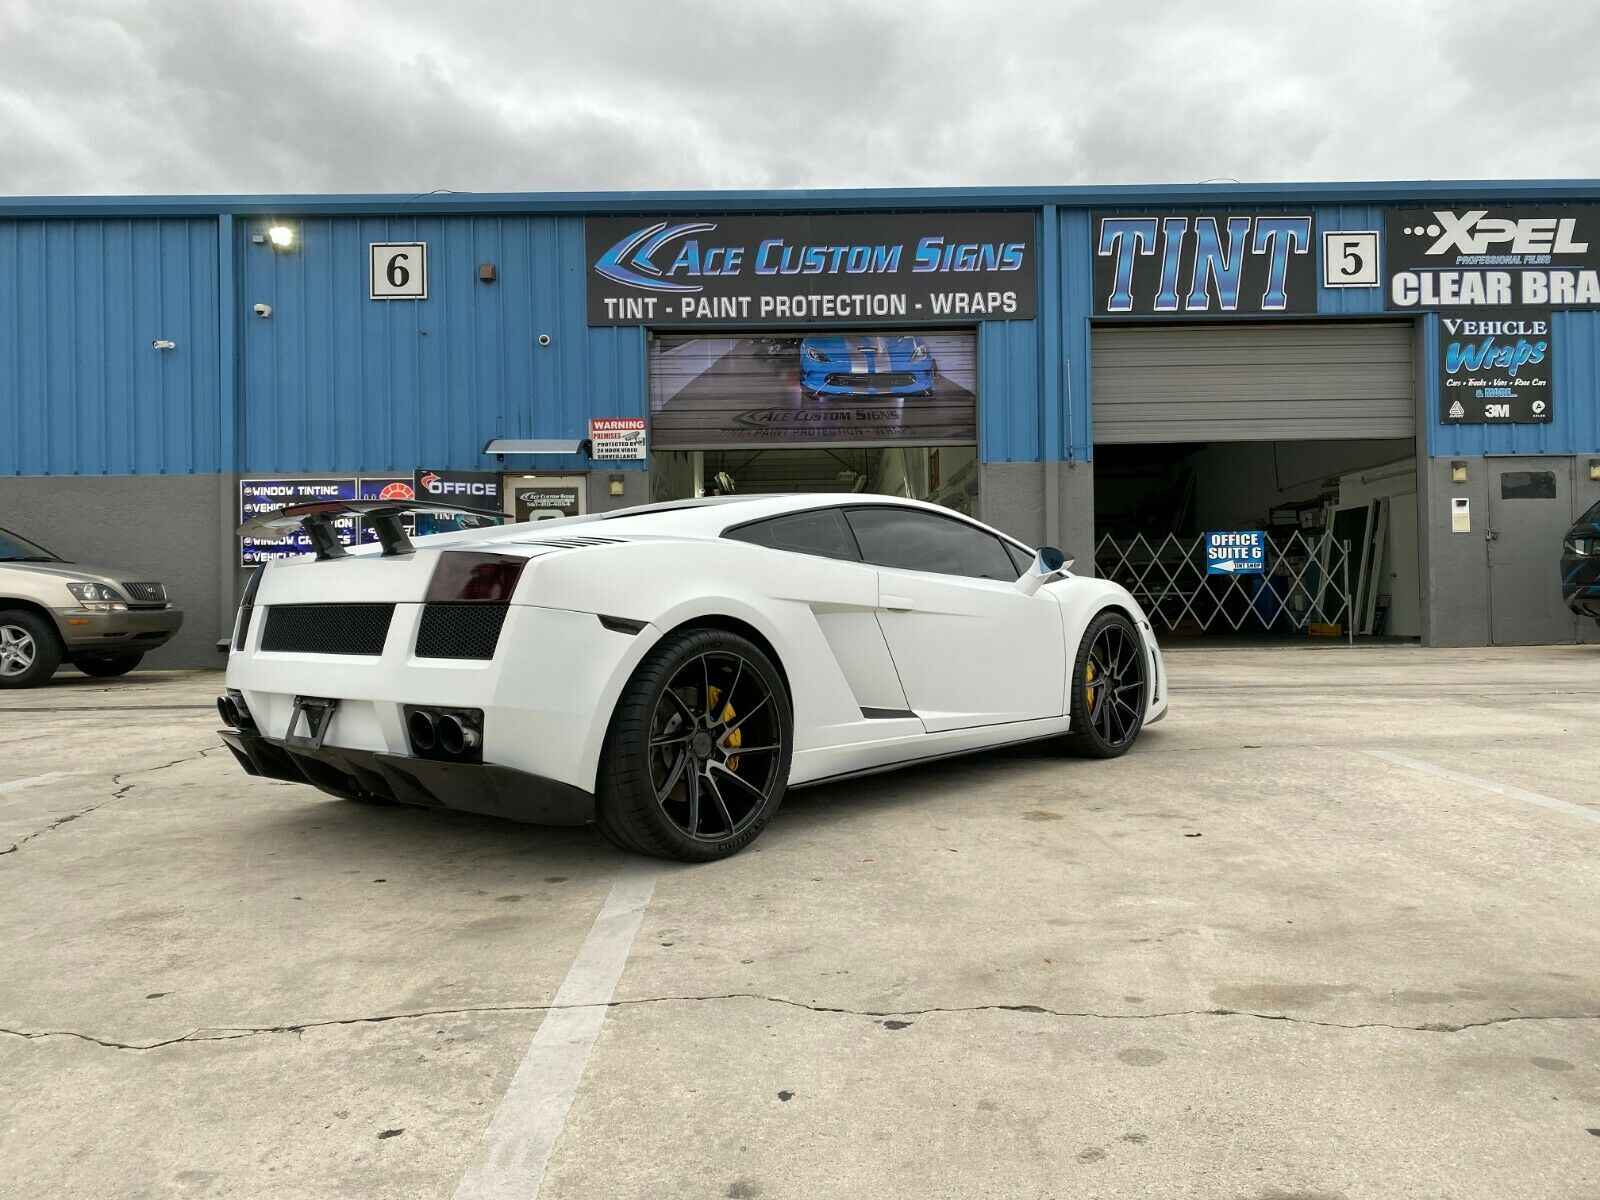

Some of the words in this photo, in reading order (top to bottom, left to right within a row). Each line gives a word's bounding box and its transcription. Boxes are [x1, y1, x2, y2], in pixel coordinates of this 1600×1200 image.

[1424, 211, 1589, 254] XPEL
[665, 239, 745, 276] ACE
[754, 238, 903, 276] CUSTOM
[912, 236, 1026, 273] SIGNS
[1340, 243, 1363, 275] 5
[1456, 255, 1522, 265] PROFESSIONAL
[1523, 255, 1551, 264] FILMS
[386, 253, 410, 288] 6
[1098, 216, 1312, 312] TINT
[1392, 271, 1512, 306] CLEAR
[1522, 270, 1600, 305] BRA
[604, 297, 657, 320] TINT
[681, 296, 752, 319] PAINT
[760, 293, 907, 318] PROTECTION
[930, 292, 1017, 314] WRAPS
[1442, 319, 1547, 336] VEHICLE
[1445, 336, 1548, 377] Wraps
[1446, 378, 1461, 387] Cars
[1467, 378, 1487, 387] Trucks
[1493, 378, 1508, 386] Vans
[1514, 378, 1530, 387] Race
[1532, 378, 1547, 386] Cars
[794, 410, 850, 422] CUSTOM
[856, 409, 899, 421] SIGNS
[1484, 404, 1510, 418] 3M
[593, 420, 645, 430] WARNING
[793, 427, 862, 437] PROTECTION
[593, 432, 621, 440] PREMISES
[252, 486, 294, 496] WINDOW
[298, 486, 339, 496] TINTING
[428, 481, 497, 496] OFFICE
[1211, 533, 1259, 546] OFFICE
[1208, 547, 1249, 560] SUITE
[1251, 546, 1262, 559] 6
